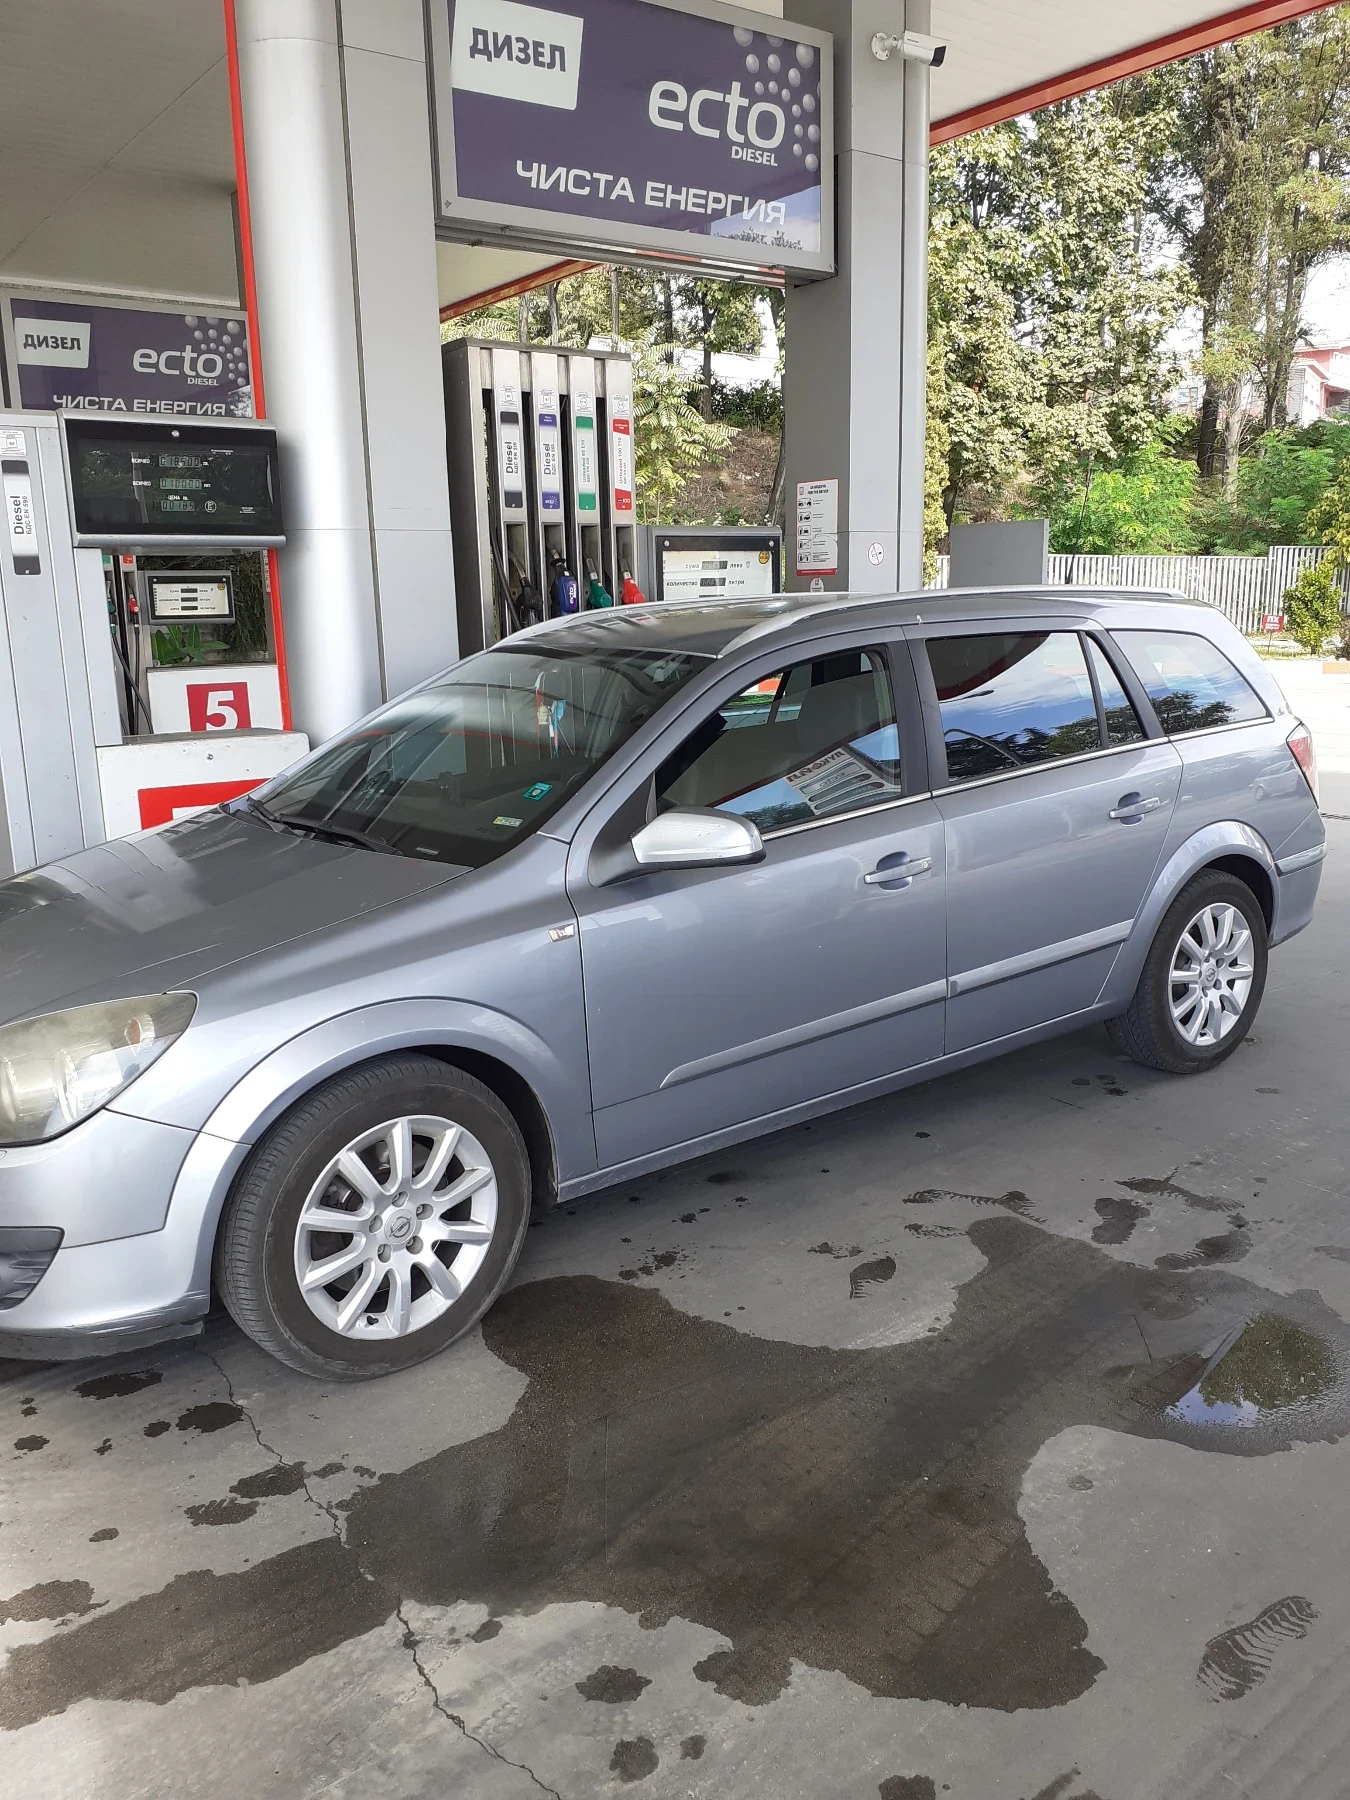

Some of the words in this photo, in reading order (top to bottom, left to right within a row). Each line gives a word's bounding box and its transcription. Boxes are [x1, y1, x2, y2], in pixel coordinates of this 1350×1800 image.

[469, 27, 566, 72] ДИЗЕЛ
[648, 80, 786, 149] ecto
[730, 145, 778, 167] DIESEL
[516, 159, 635, 203] ЧИСТА
[644, 181, 786, 225] ЕНЕРГИЯ
[23, 334, 82, 351] ДИЗЕЛ
[132, 345, 223, 378] ecto
[187, 377, 219, 387] DIESEL
[53, 394, 127, 412] ЧИСТА
[133, 399, 226, 416] ЕНЕРГИЯ
[504, 441, 513, 474] Diesel
[543, 443, 552, 475] Diesel
[10, 495, 25, 535] Diesel
[23, 508, 30, 519] EN
[205, 689, 238, 732] 5
